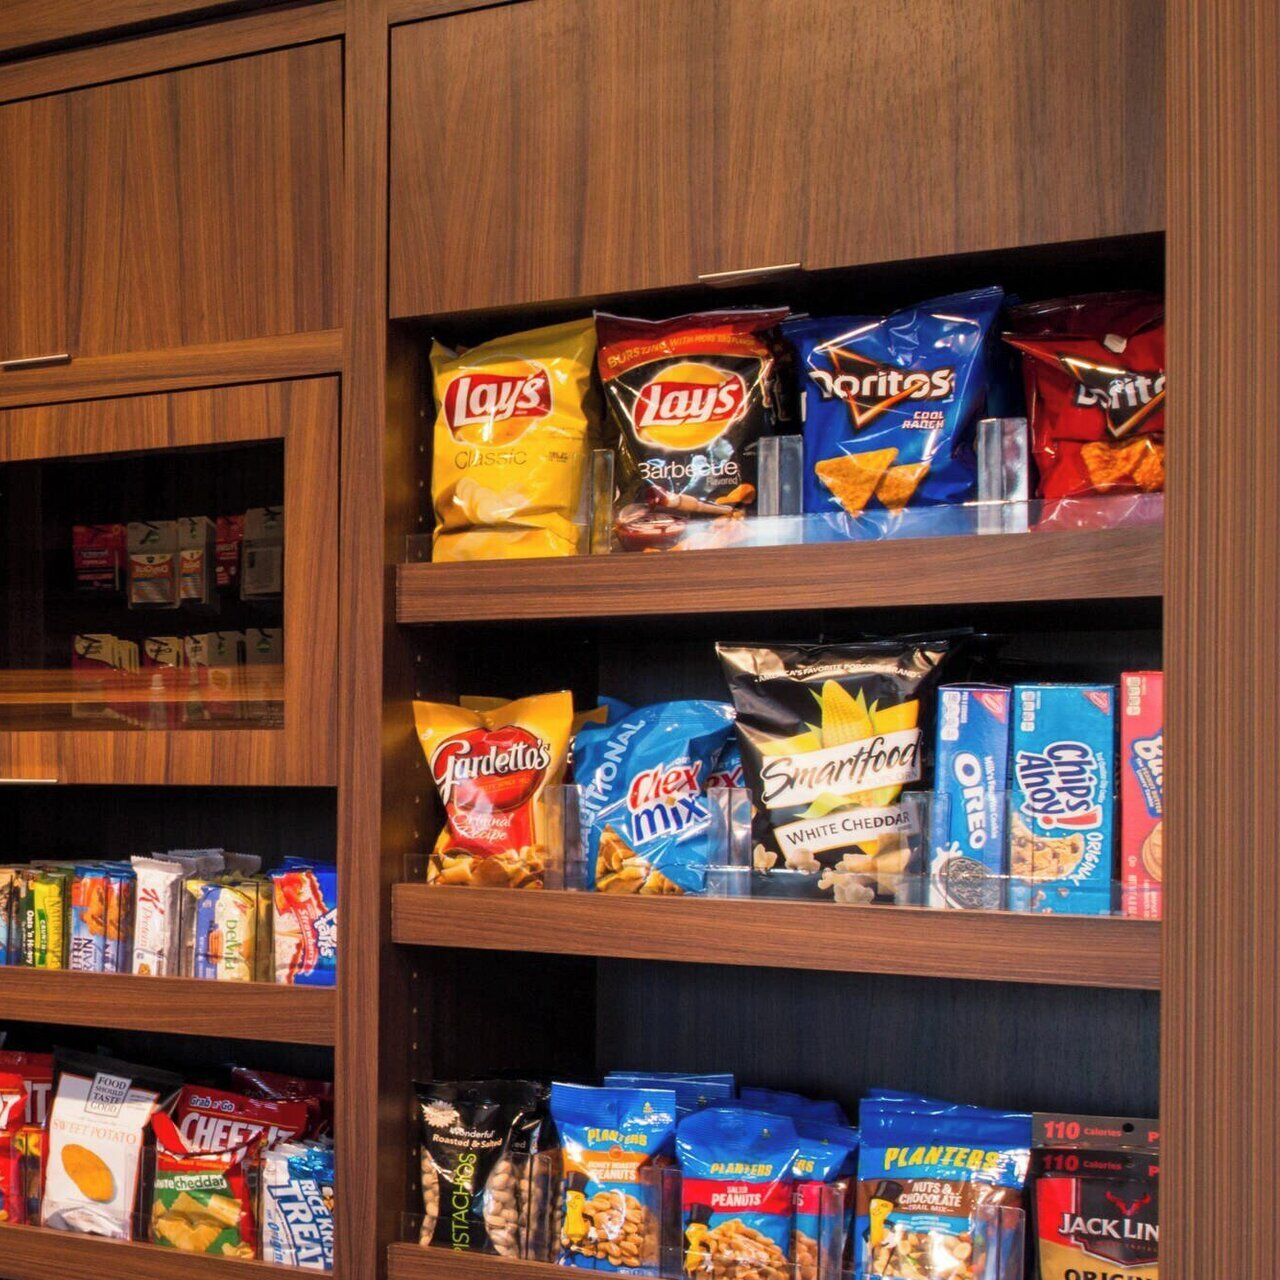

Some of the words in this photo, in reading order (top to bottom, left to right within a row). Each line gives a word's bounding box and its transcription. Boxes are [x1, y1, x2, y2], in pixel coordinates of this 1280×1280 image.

[807, 367, 956, 400] Doritos
[453, 367, 548, 428] Lay's
[639, 373, 742, 428] Lay's
[901, 420, 945, 430] RANCH
[913, 410, 945, 420] COOL
[453, 448, 527, 470] Classic
[638, 459, 740, 480] Barbecue
[430, 738, 552, 807] Gardetto's
[761, 731, 924, 805] Smartfood
[1047, 743, 1095, 814] Chips
[953, 752, 987, 850] OREO
[1018, 751, 1102, 831] Ahoy!
[786, 824, 840, 849] WHITE
[841, 809, 911, 834] CHEDDAR
[1072, 832, 1105, 887] ORIGINAL
[97, 1075, 127, 1090] FOOD
[90, 1101, 118, 1114] GOOD
[93, 1092, 122, 1105] TASTE
[190, 1094, 212, 1108] Grab
[220, 1101, 235, 1113] Go
[52, 1118, 91, 1136] SWEET
[91, 1126, 137, 1145] POTATO
[449, 1126, 496, 1139] Wonderful
[1043, 1120, 1081, 1140] 110
[1083, 1126, 1123, 1138] calories
[432, 1133, 470, 1148] Roasted
[884, 1145, 1001, 1172] PLANTERS
[1043, 1154, 1080, 1172] 110
[1082, 1159, 1122, 1171] calories
[710, 1162, 773, 1177] PLANTERS
[174, 1174, 228, 1191] cheddar
[726, 1186, 749, 1194] SALTED
[911, 1181, 941, 1195] NUTS
[711, 1193, 762, 1208] PEANUTS
[899, 1192, 963, 1207] CHOCOLATE
[1058, 1212, 1122, 1240] JACK
